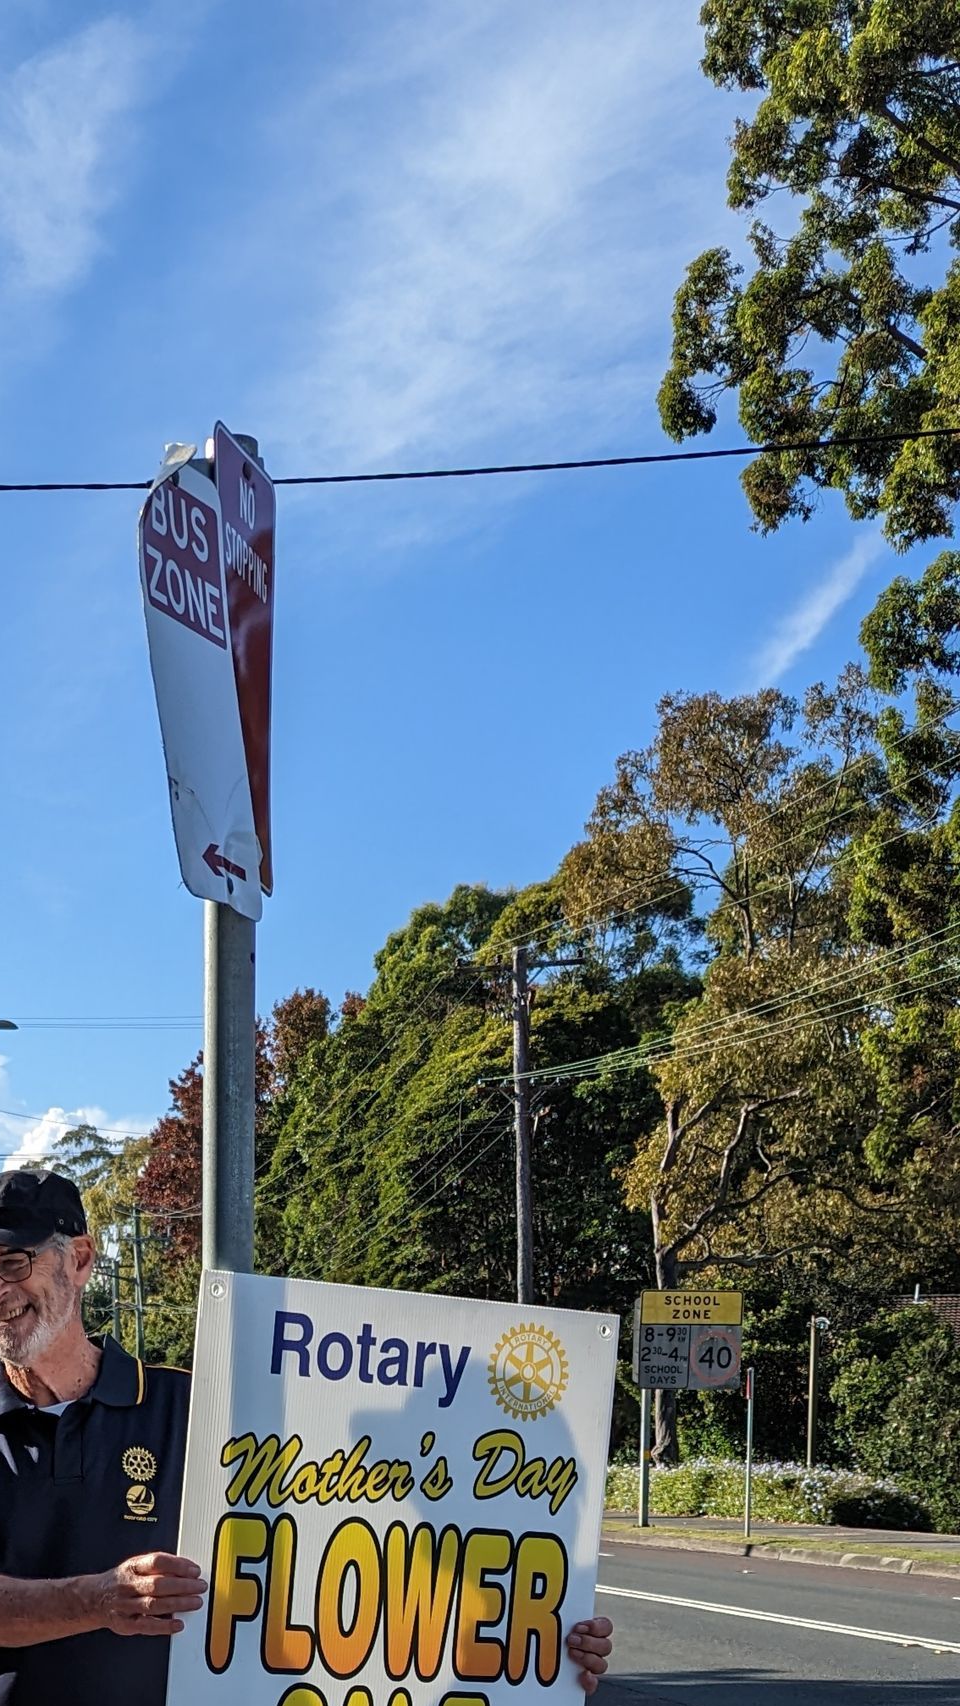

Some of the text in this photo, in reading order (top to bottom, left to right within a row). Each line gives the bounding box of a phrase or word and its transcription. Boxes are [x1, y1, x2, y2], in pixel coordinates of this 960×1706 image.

[151, 485, 209, 563] BUS
[240, 478, 256, 530] NO
[225, 521, 268, 604] STOPPING
[146, 543, 225, 641] ZONE
[664, 1295, 721, 1306] SCHOOL
[672, 1309, 712, 1320] ZONE
[270, 1310, 472, 1408] Rotary
[514, 1333, 549, 1346] ROTARY
[698, 1346, 733, 1369] 40
[644, 1365, 683, 1374] SCHOOL
[650, 1375, 677, 1385] DAYS
[499, 1383, 557, 1411] INTERNATIONAL
[220, 1428, 579, 1516] Mother's Day
[205, 1511, 569, 1688] FLOWER
